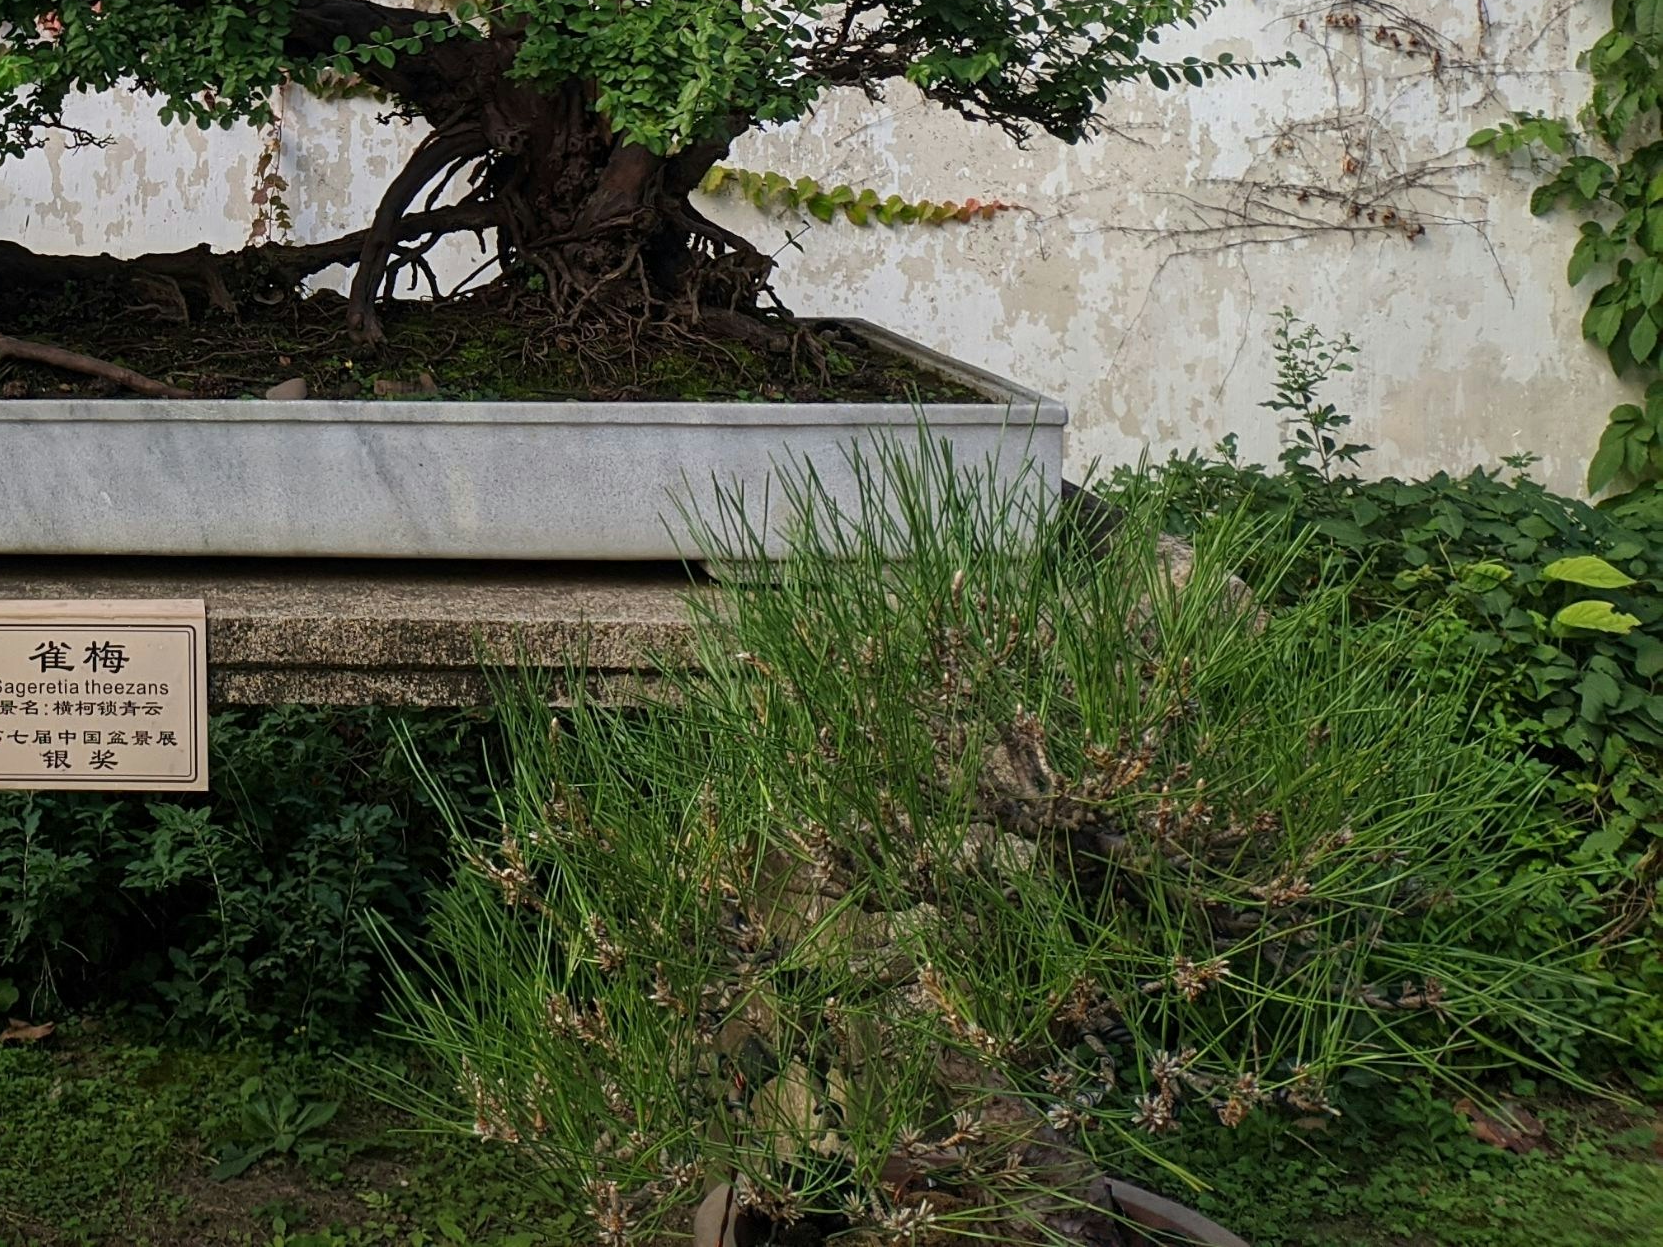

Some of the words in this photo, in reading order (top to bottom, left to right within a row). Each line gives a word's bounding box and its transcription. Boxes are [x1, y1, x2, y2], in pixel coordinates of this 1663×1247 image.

[28, 640, 130, 673] 雀梅
[85, 679, 169, 695] theezans
[42, 749, 119, 770] 银奖
